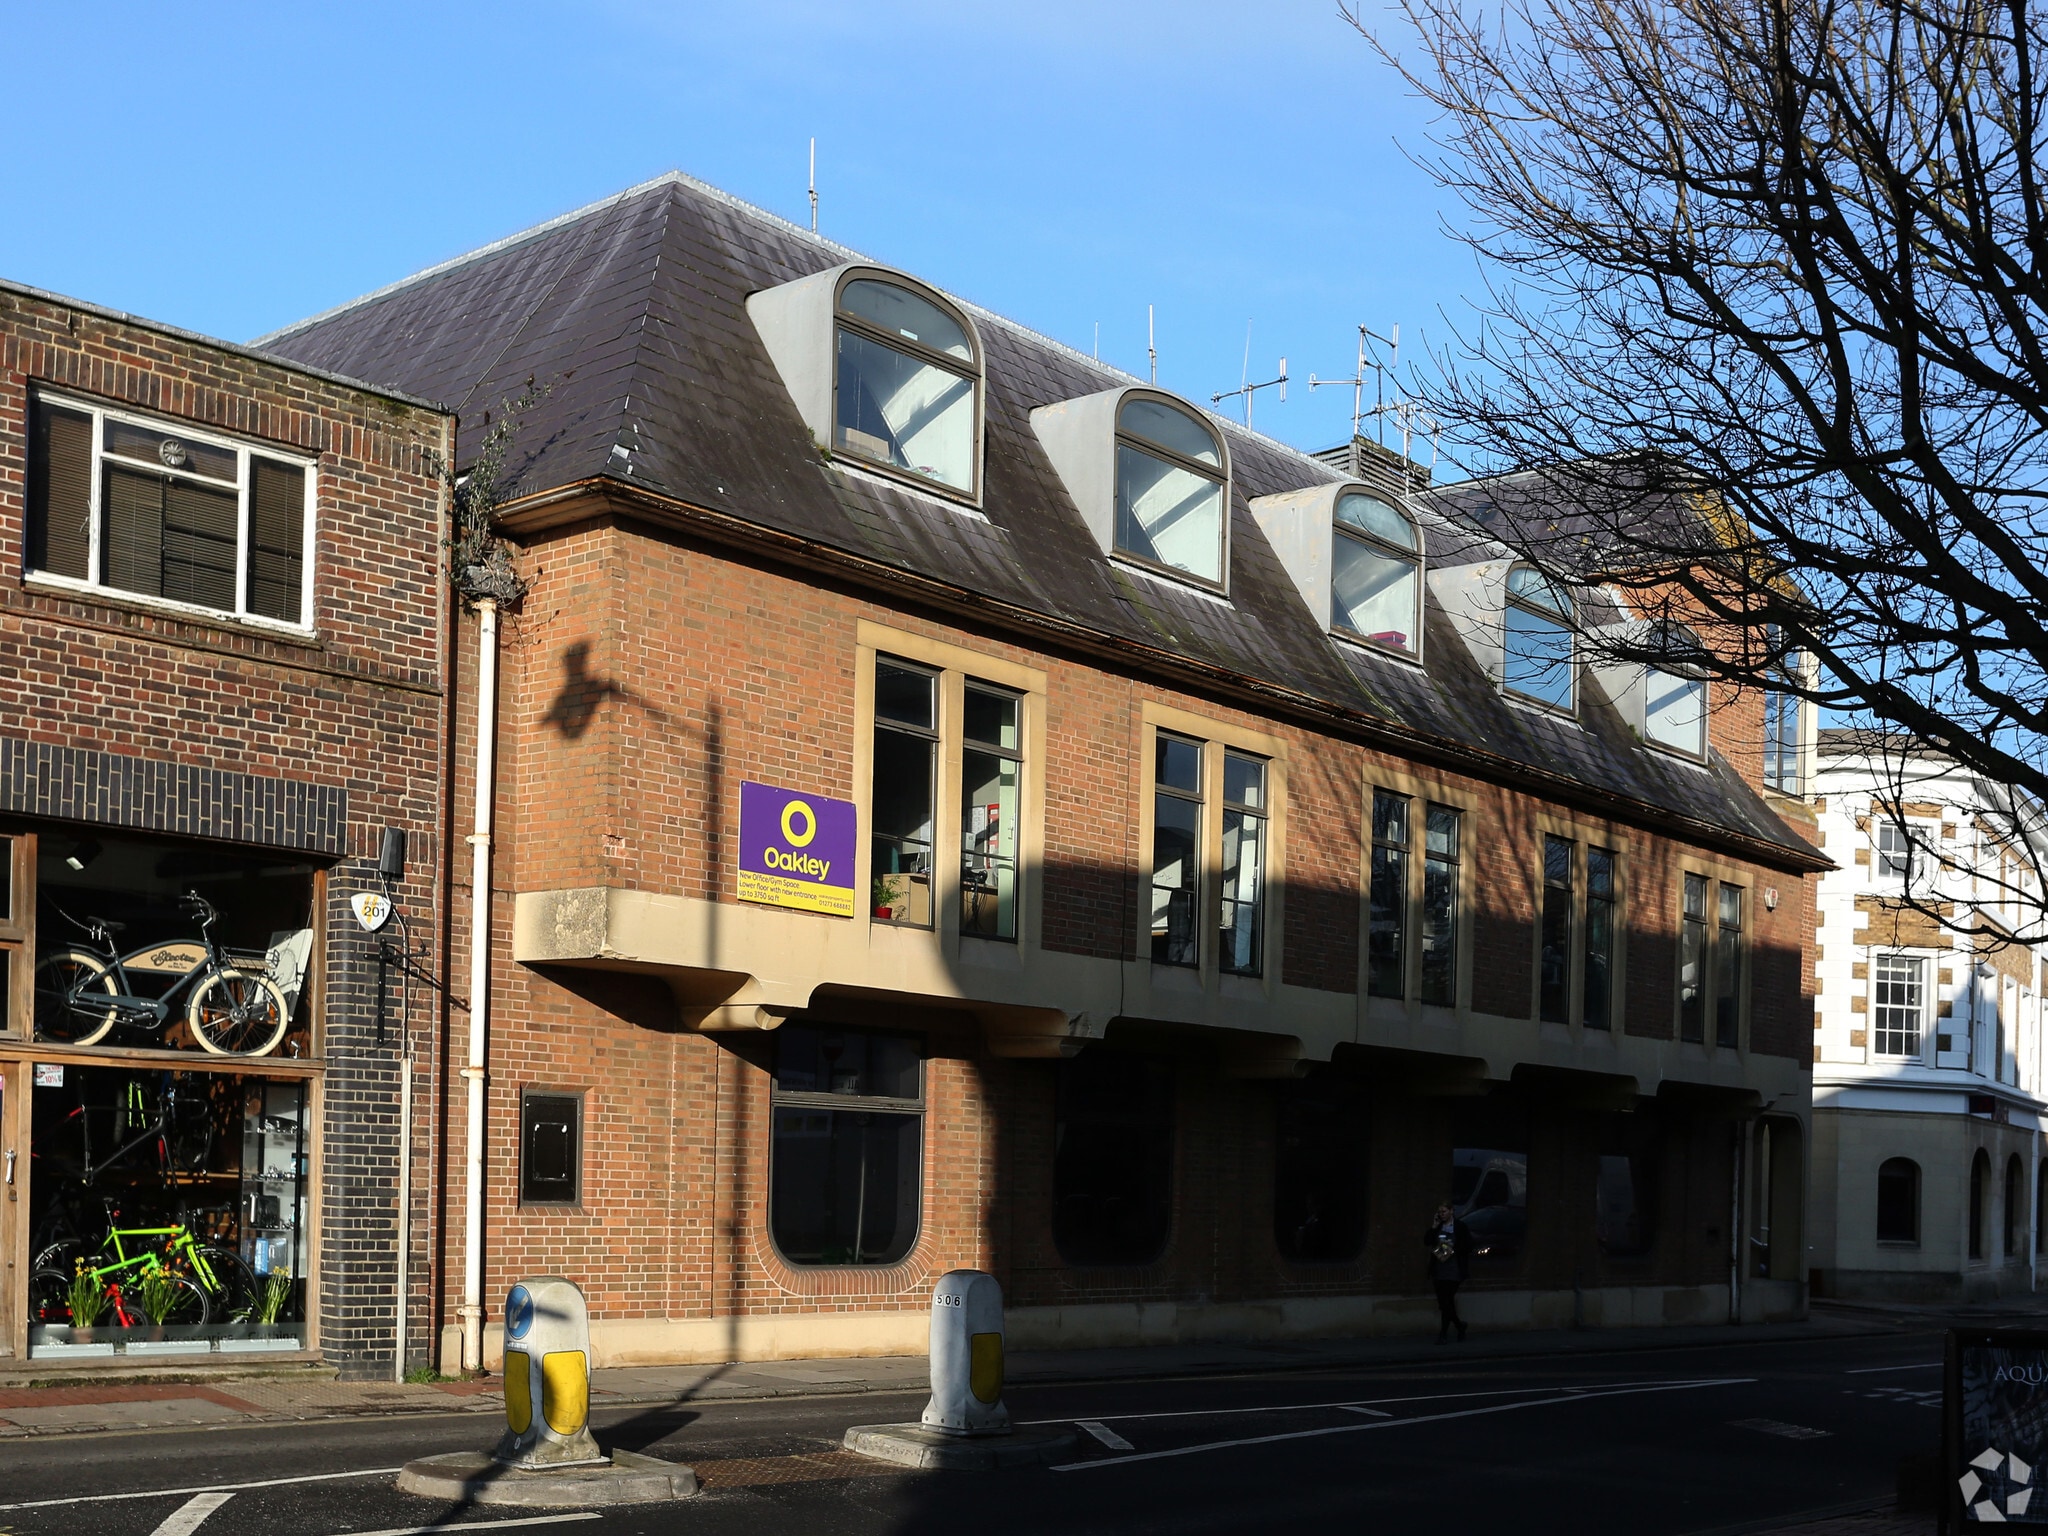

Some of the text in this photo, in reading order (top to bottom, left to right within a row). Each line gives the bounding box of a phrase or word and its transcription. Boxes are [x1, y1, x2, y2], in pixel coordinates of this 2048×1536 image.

[764, 847, 831, 881] Oakley
[739, 872, 800, 888] New Office/Gym Space
[739, 880, 756, 889] Lower
[757, 883, 769, 891] floor
[770, 886, 781, 894] with
[794, 891, 818, 900] entrance
[739, 889, 746, 898] up
[754, 891, 767, 900] 3750
[768, 894, 774, 902] sq
[818, 899, 832, 908] 01273
[364, 906, 385, 918] 201
[937, 1295, 961, 1307] 506
